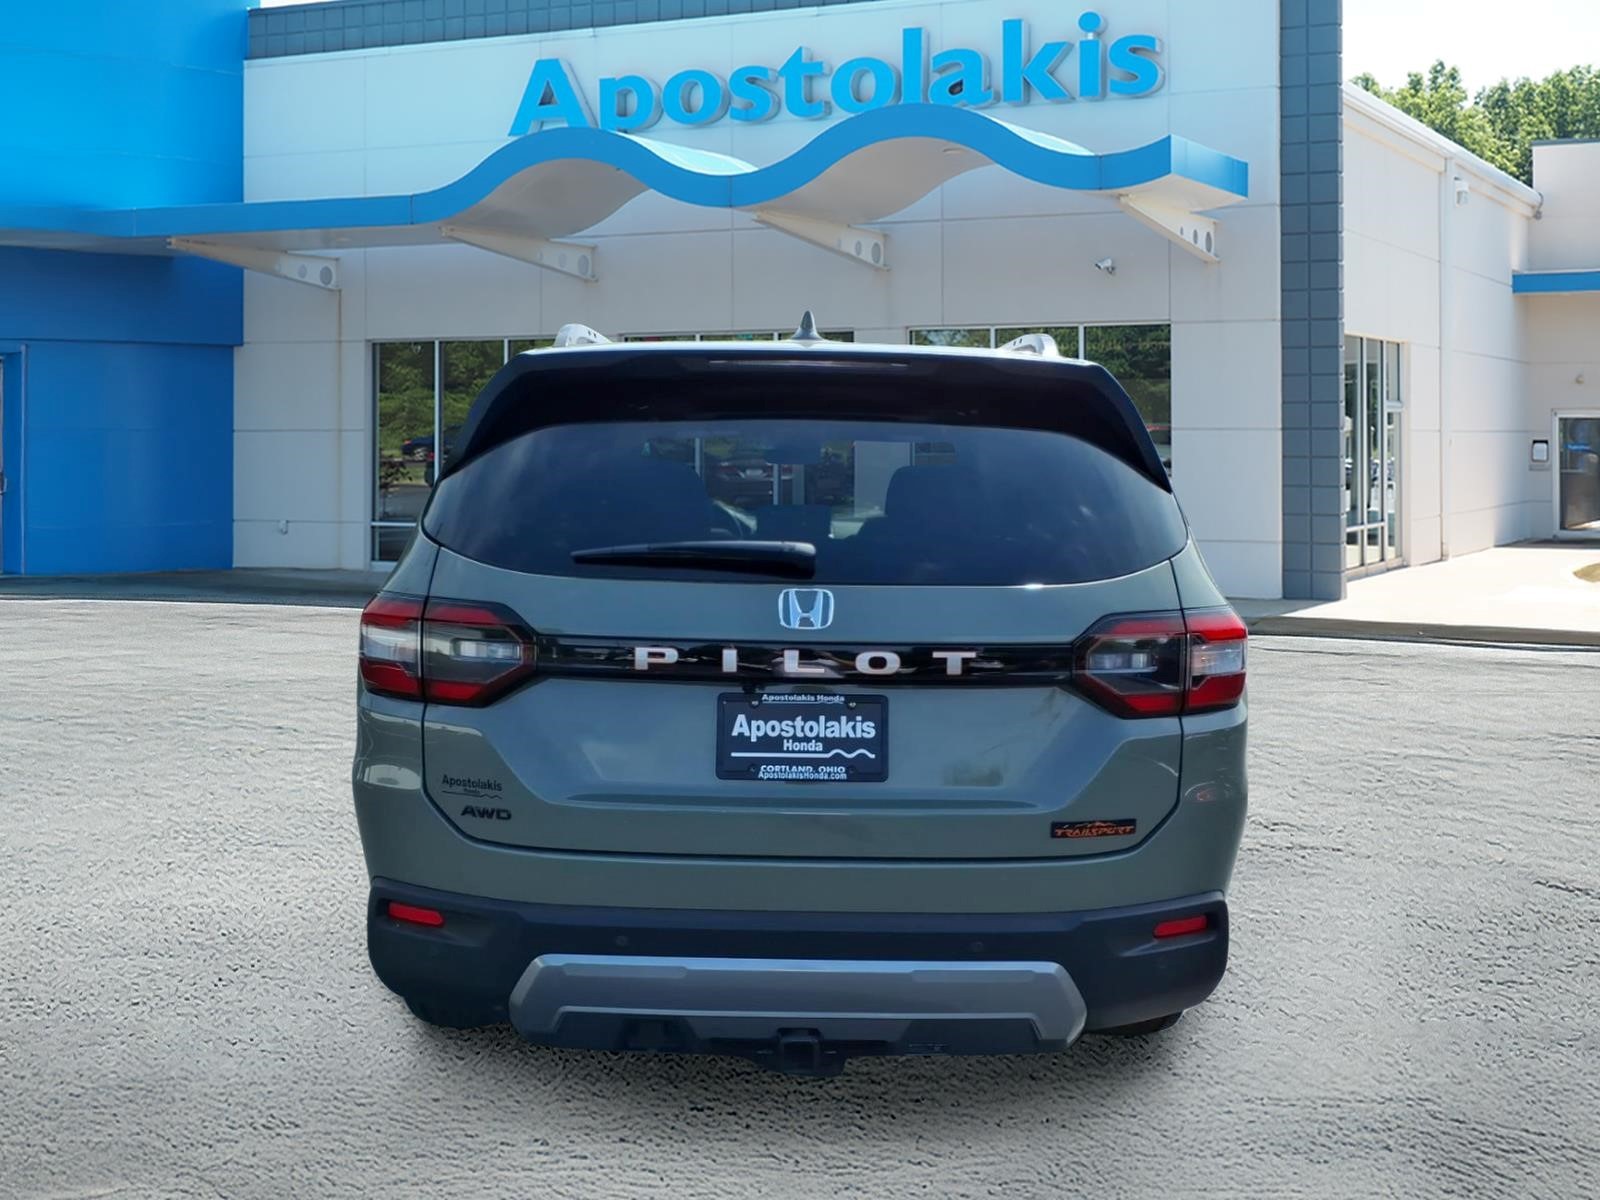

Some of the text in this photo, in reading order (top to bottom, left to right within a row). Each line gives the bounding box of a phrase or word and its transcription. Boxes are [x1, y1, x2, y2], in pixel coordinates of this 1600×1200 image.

[508, 11, 1165, 137] Apostolakis
[634, 646, 977, 676] PILOT
[762, 694, 815, 702] Apostolakis
[731, 714, 876, 742] Apostolakis
[783, 739, 823, 751] Honda
[442, 774, 502, 791] Apostolakis
[758, 771, 847, 780] ApostolakisHonda.com
[461, 805, 512, 820] AWD
